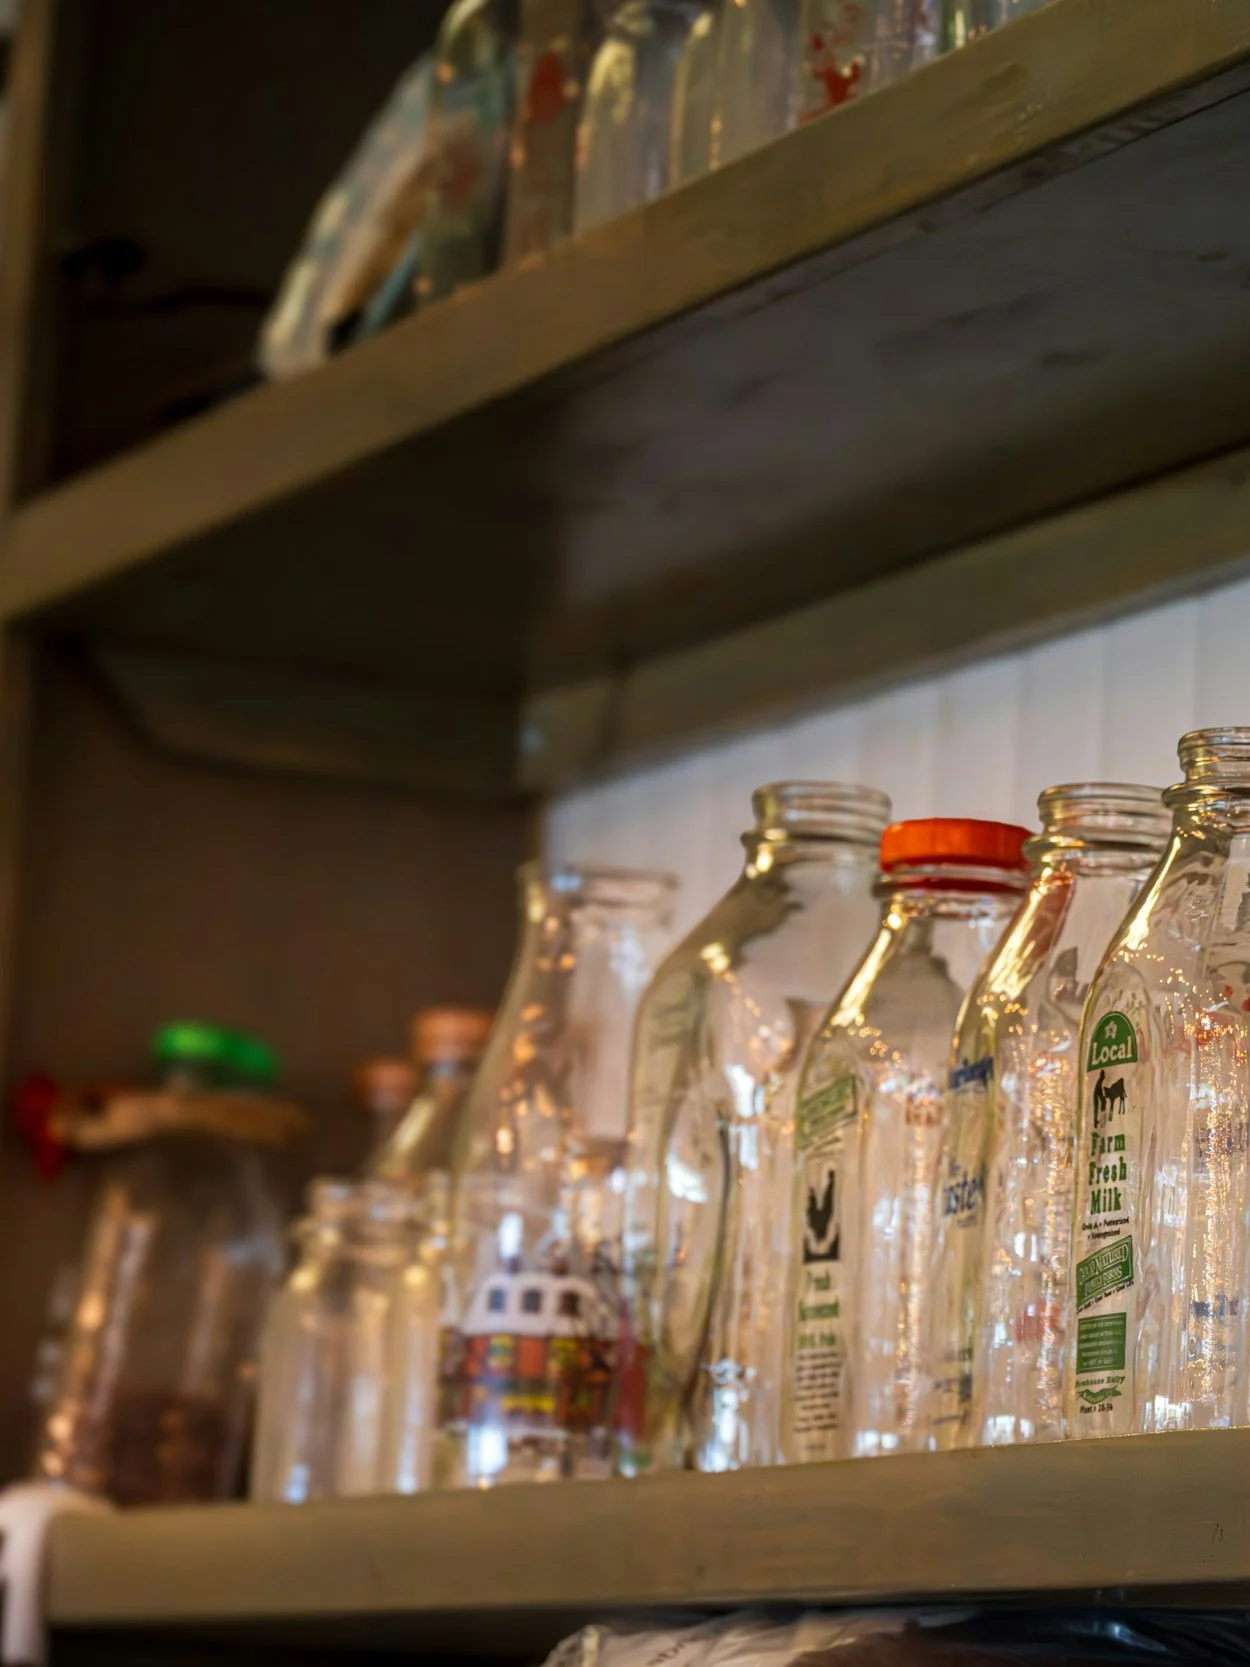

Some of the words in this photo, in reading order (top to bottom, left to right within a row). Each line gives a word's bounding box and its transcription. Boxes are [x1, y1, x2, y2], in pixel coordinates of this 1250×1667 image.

[1091, 1035, 1132, 1065] Local
[1091, 1132, 1125, 1156] Farm
[1089, 1156, 1126, 1185] Fresh
[1090, 1187, 1121, 1214] Milk
